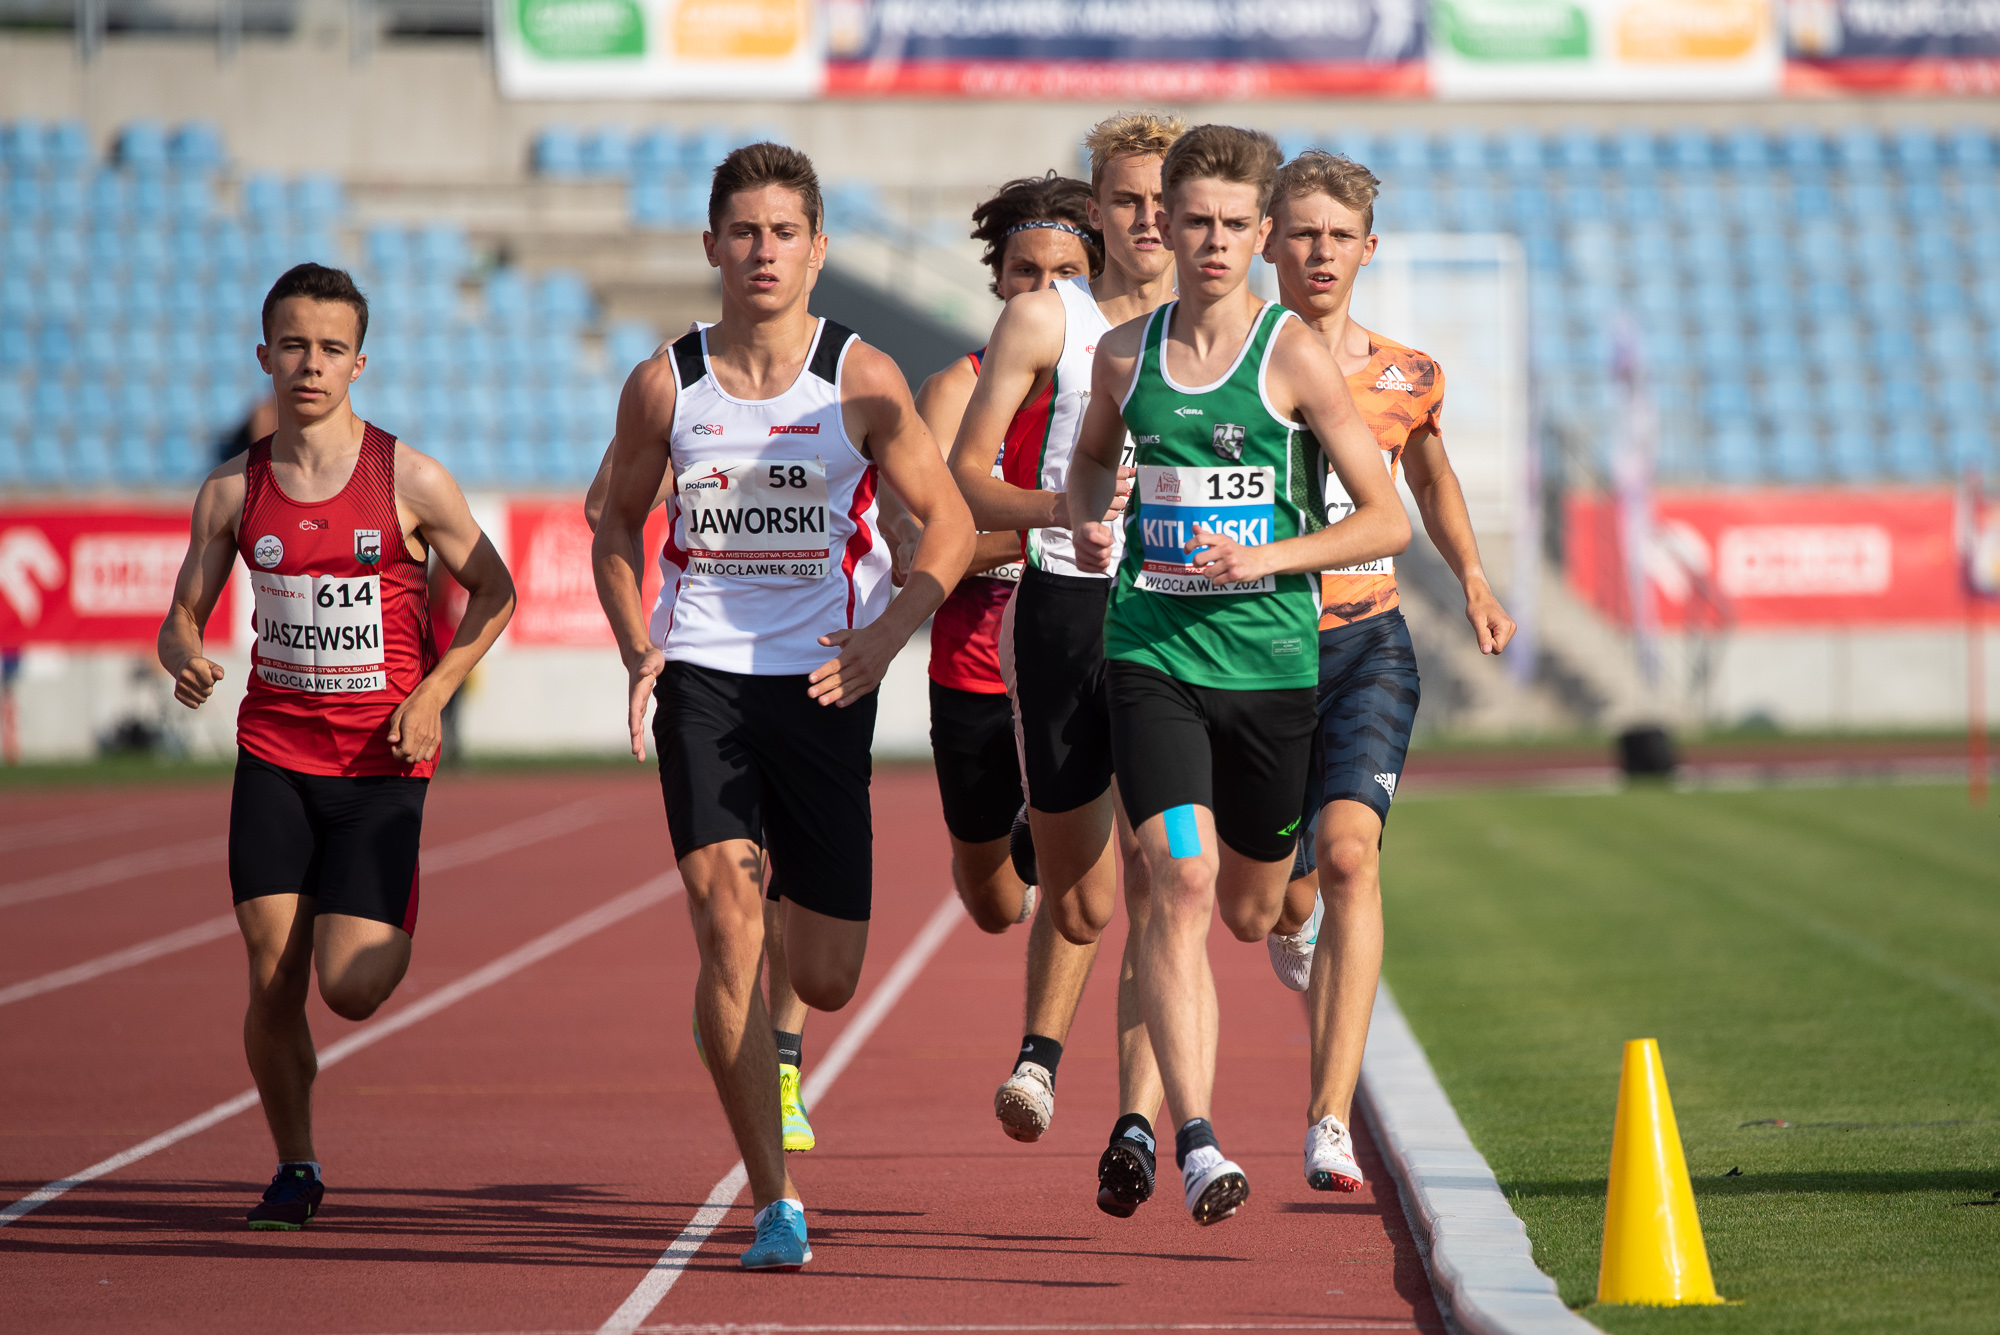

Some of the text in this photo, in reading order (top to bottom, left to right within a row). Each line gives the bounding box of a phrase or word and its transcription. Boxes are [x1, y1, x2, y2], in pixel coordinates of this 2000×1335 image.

[1376, 379, 1413, 392] adidas
[685, 481, 719, 491] polanik
[769, 465, 808, 489] 58
[1207, 472, 1265, 500] 135
[690, 506, 825, 535] JAWORSKI
[1142, 514, 1268, 549] KITLŃSKI
[692, 550, 704, 558] 53.
[726, 551, 781, 559] MISTRZOSTWA
[694, 562, 823, 576] WŁOCŁAWEK 2021
[1233, 577, 1266, 590] 2021
[316, 581, 373, 608] 614
[262, 617, 379, 651] JASZEWSKI
[273, 660, 288, 669] PZLA
[288, 664, 337, 673] MISTRZOSTWA
[263, 669, 378, 690] WŁOCŁAWEK 2021
